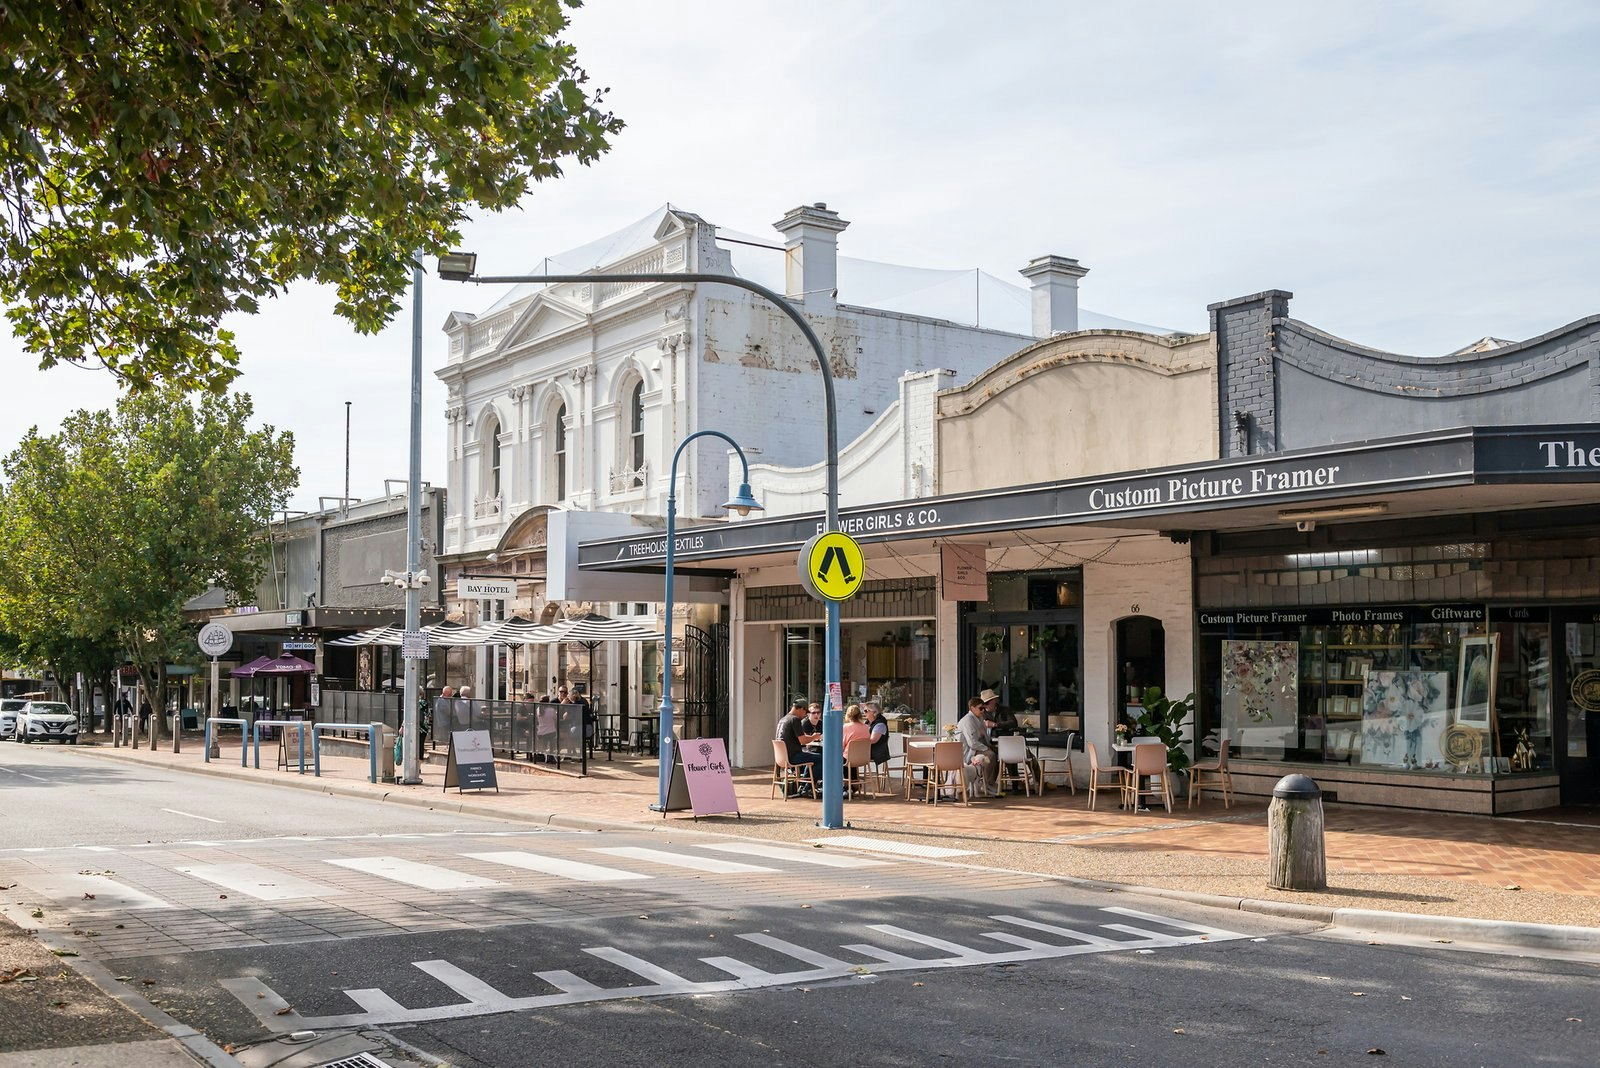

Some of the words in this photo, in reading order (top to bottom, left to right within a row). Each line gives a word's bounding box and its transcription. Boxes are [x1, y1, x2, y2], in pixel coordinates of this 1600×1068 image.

[1539, 441, 1600, 468] The
[1088, 488, 1162, 510] Custom
[1167, 477, 1243, 502] Picture
[1249, 466, 1340, 493] Framer
[816, 518, 864, 536] FWER
[866, 514, 902, 531] GIRLS
[906, 511, 916, 526] &
[918, 509, 942, 525] CO.
[674, 535, 704, 551] EXTILES
[467, 585, 482, 593] BAY
[484, 586, 510, 594] HOTEL
[1131, 603, 1140, 613] 66
[1431, 607, 1482, 620] Giftware
[1508, 607, 1530, 619] Cards
[1200, 613, 1234, 624] Custom
[1236, 612, 1269, 623] Picture
[1271, 612, 1307, 623] Framer
[1332, 610, 1361, 621] Photo
[1364, 609, 1404, 620] Frames
[687, 763, 707, 771] Flower
[710, 761, 725, 770] Girls
